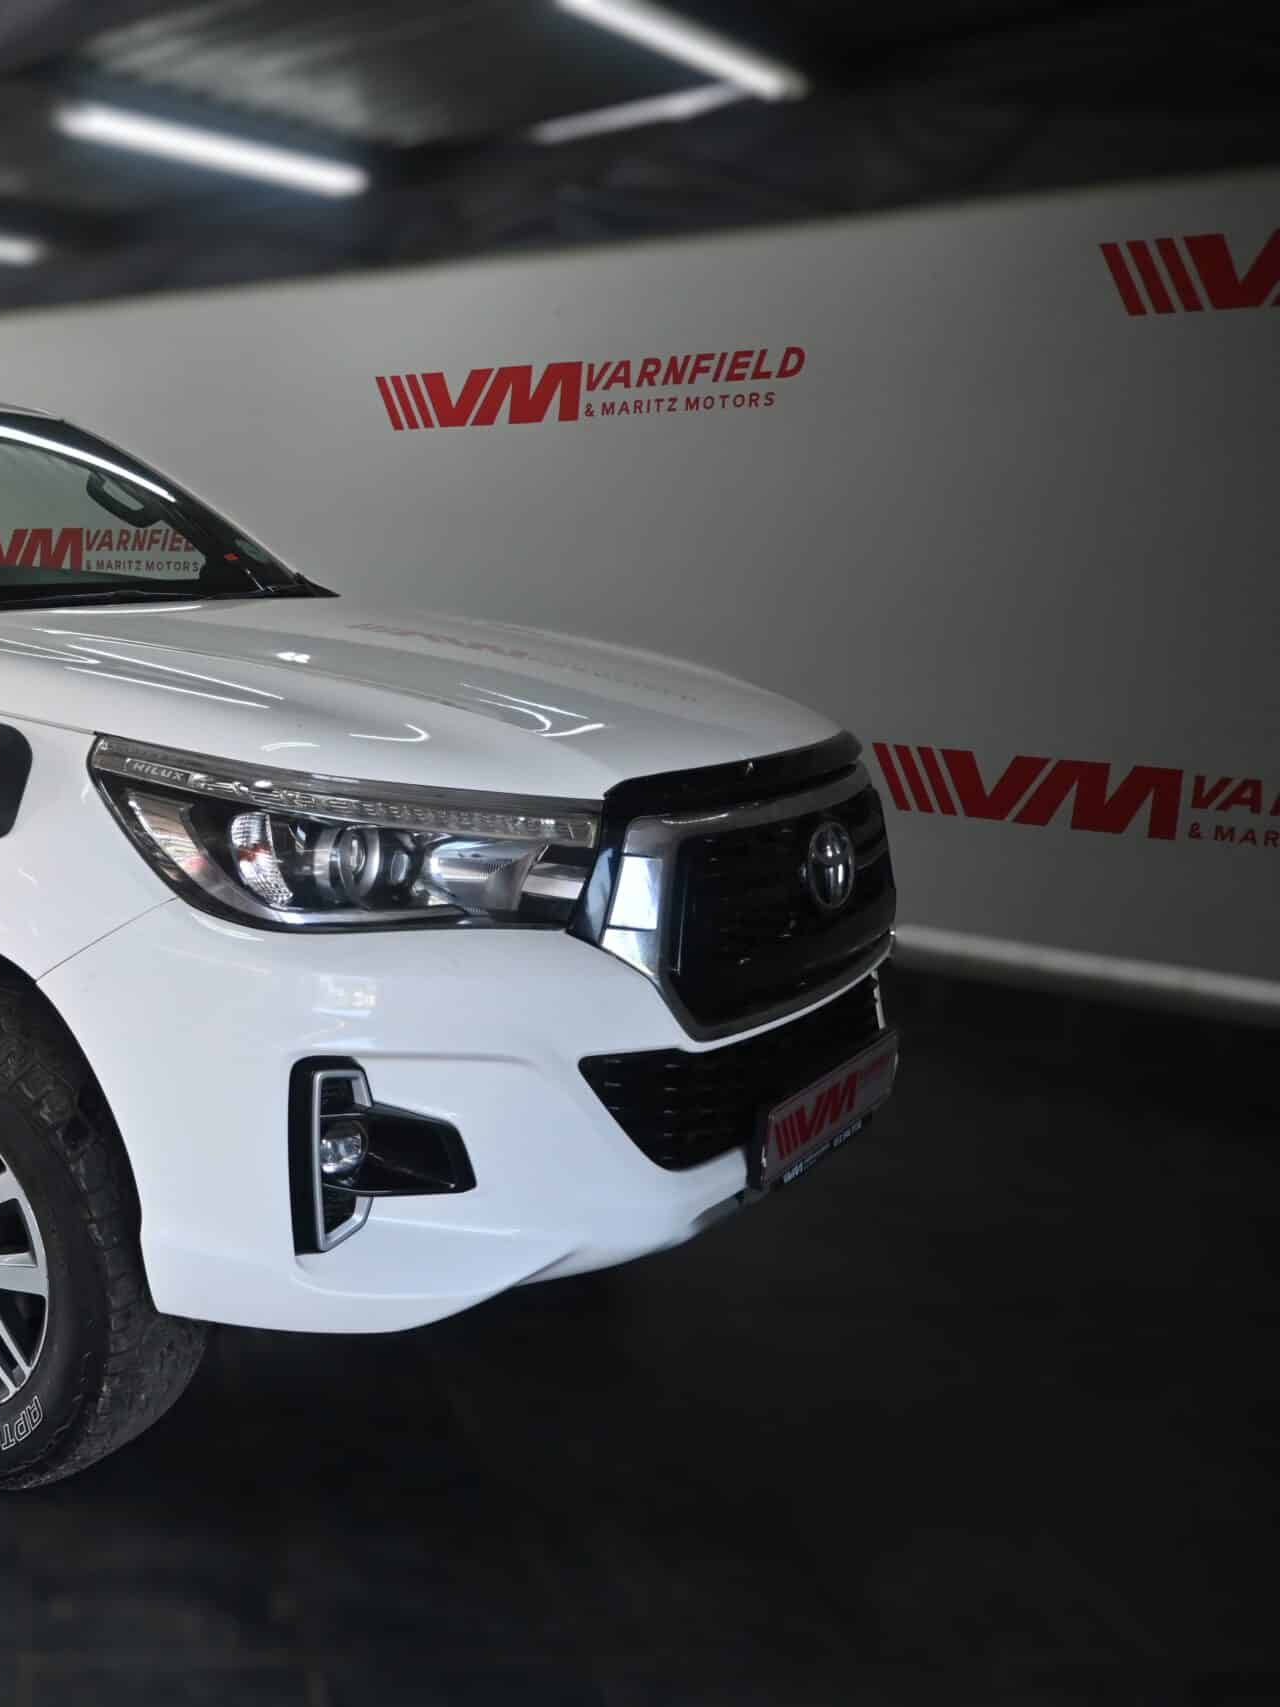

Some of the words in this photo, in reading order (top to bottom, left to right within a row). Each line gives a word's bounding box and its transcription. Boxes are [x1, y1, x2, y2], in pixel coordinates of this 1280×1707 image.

[586, 346, 806, 392] VARNFIELD
[422, 361, 583, 428] VM
[585, 404, 595, 417] &
[601, 396, 677, 416] MARITZ
[685, 391, 776, 412] MOTORS
[96, 559, 143, 572] MARITZ
[145, 559, 199, 572] MOTORS
[133, 762, 185, 781] HILUX
[940, 747, 1184, 841] VM
[1188, 822, 1202, 840] &
